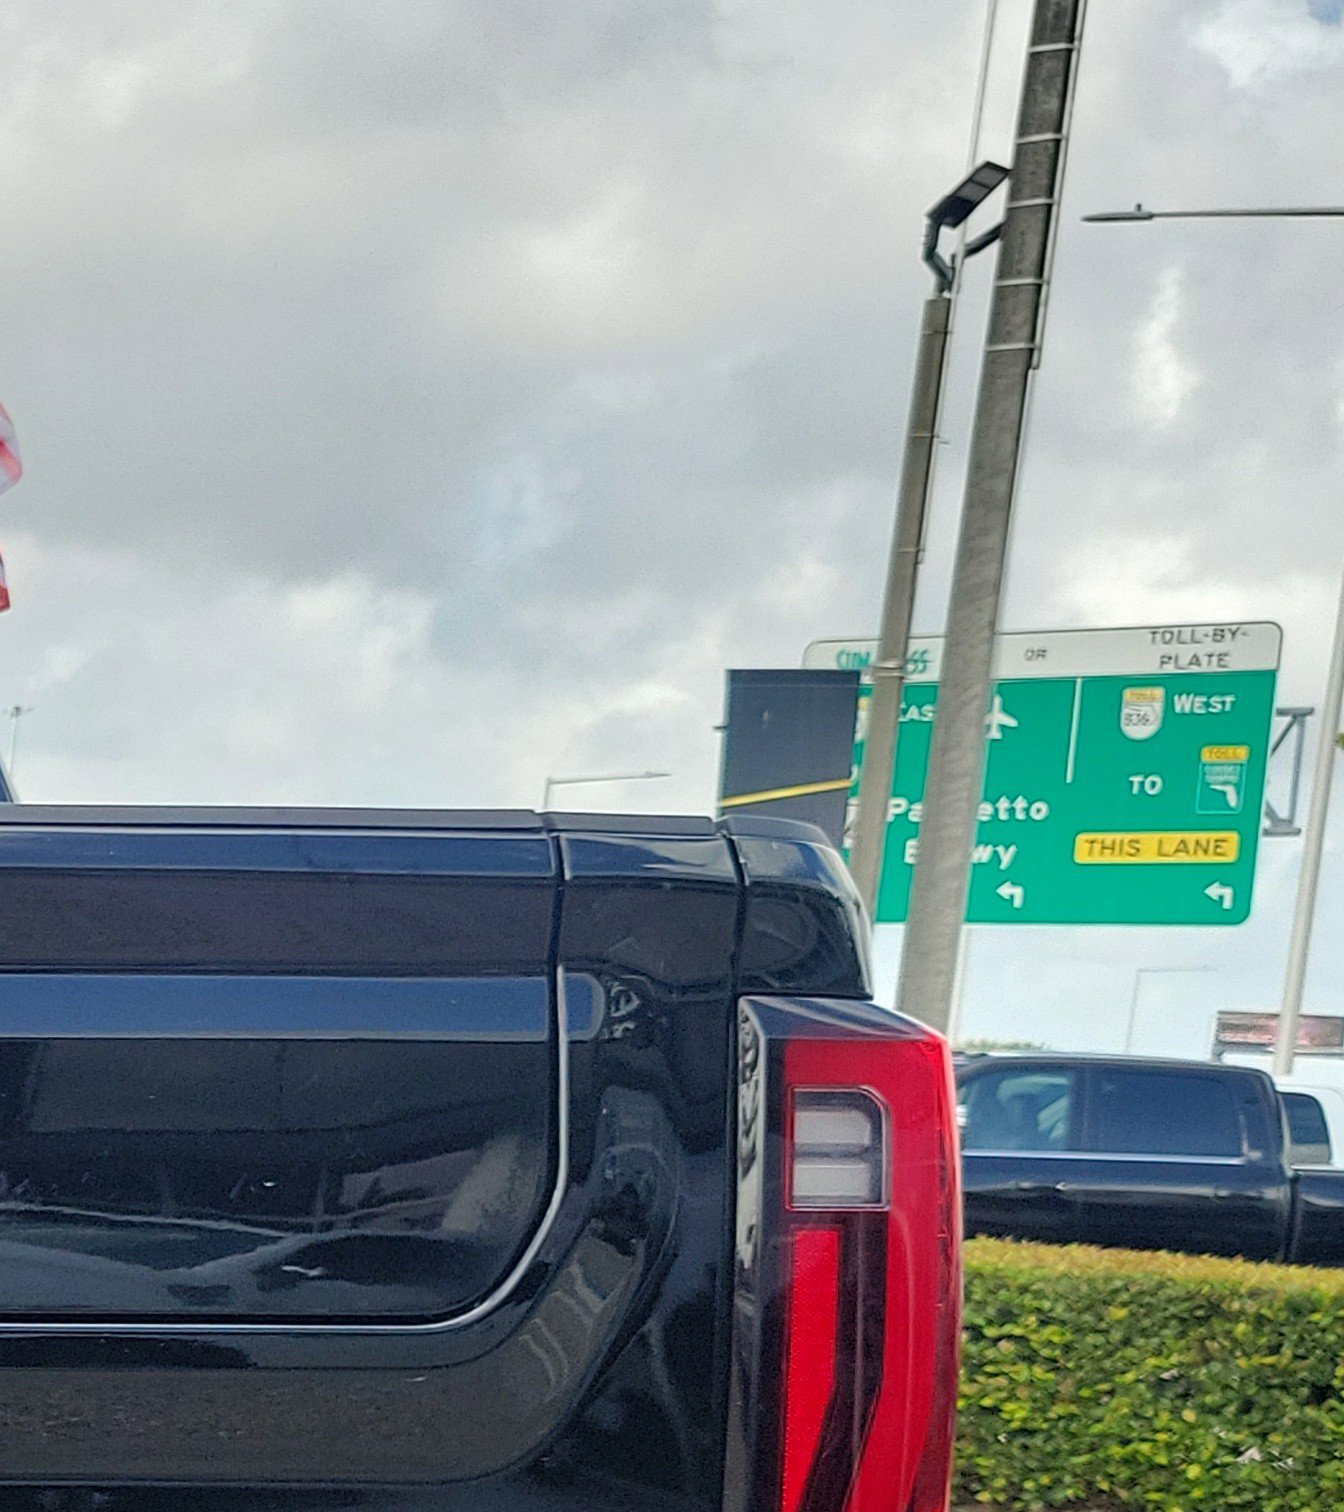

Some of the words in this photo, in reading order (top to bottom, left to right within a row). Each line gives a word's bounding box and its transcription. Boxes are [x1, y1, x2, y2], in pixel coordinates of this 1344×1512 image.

[1159, 652, 1231, 670] PLATE
[1173, 692, 1236, 715] WEST
[1129, 774, 1163, 796] TO
[885, 795, 1049, 822] Paetto
[1085, 838, 1141, 858] THIS
[1157, 837, 1229, 858] LANE
